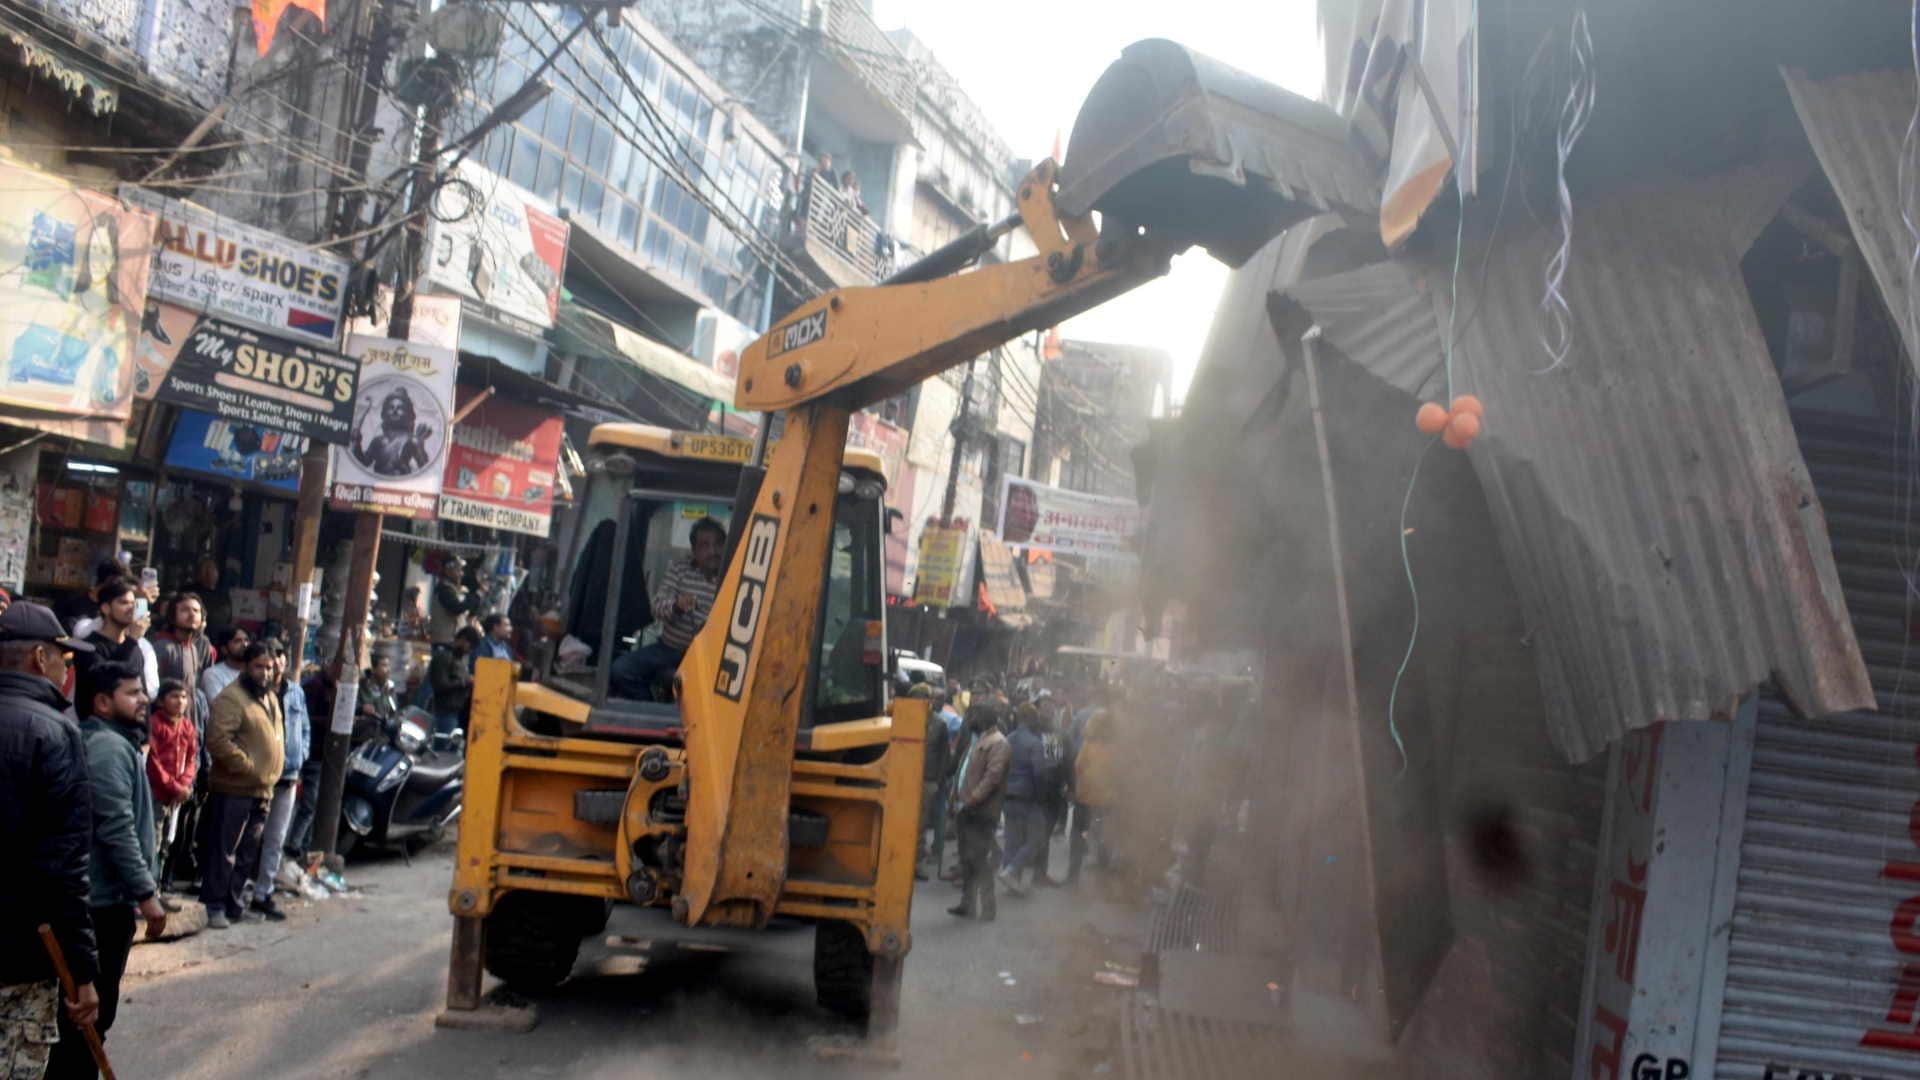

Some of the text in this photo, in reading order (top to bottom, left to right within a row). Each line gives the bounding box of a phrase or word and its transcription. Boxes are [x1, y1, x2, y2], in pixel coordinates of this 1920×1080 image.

[194, 332, 234, 367] My
[233, 343, 353, 402] SHOE'S
[170, 376, 349, 433] Sports Shoes Leather Shoes Nagra
[217, 401, 250, 420] Sports
[252, 408, 285, 429] Sandle
[450, 500, 495, 523] TRADING
[495, 508, 542, 532] COMPANY
[724, 518, 777, 697] JCB
